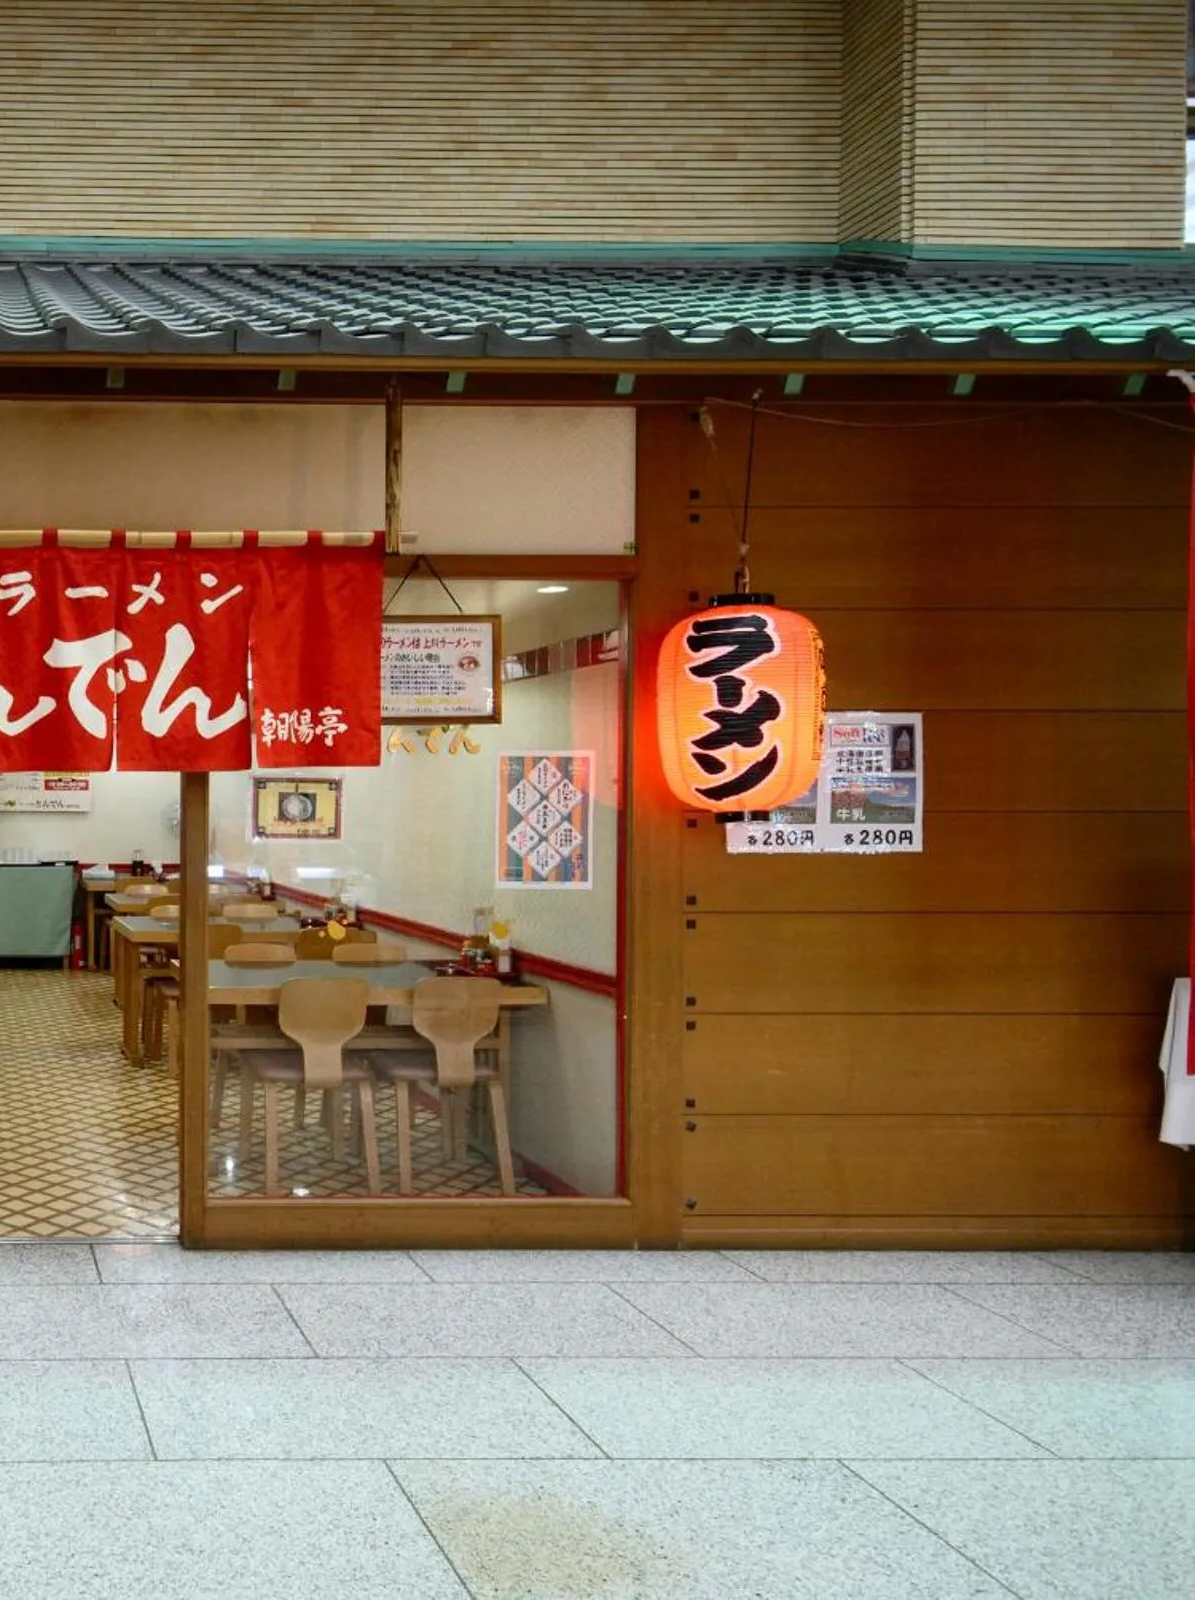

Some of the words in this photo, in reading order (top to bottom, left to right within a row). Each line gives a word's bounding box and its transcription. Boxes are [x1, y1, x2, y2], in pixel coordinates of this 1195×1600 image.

[261, 706, 348, 748] 朝陽亭
[686, 614, 781, 801] ラーメン
